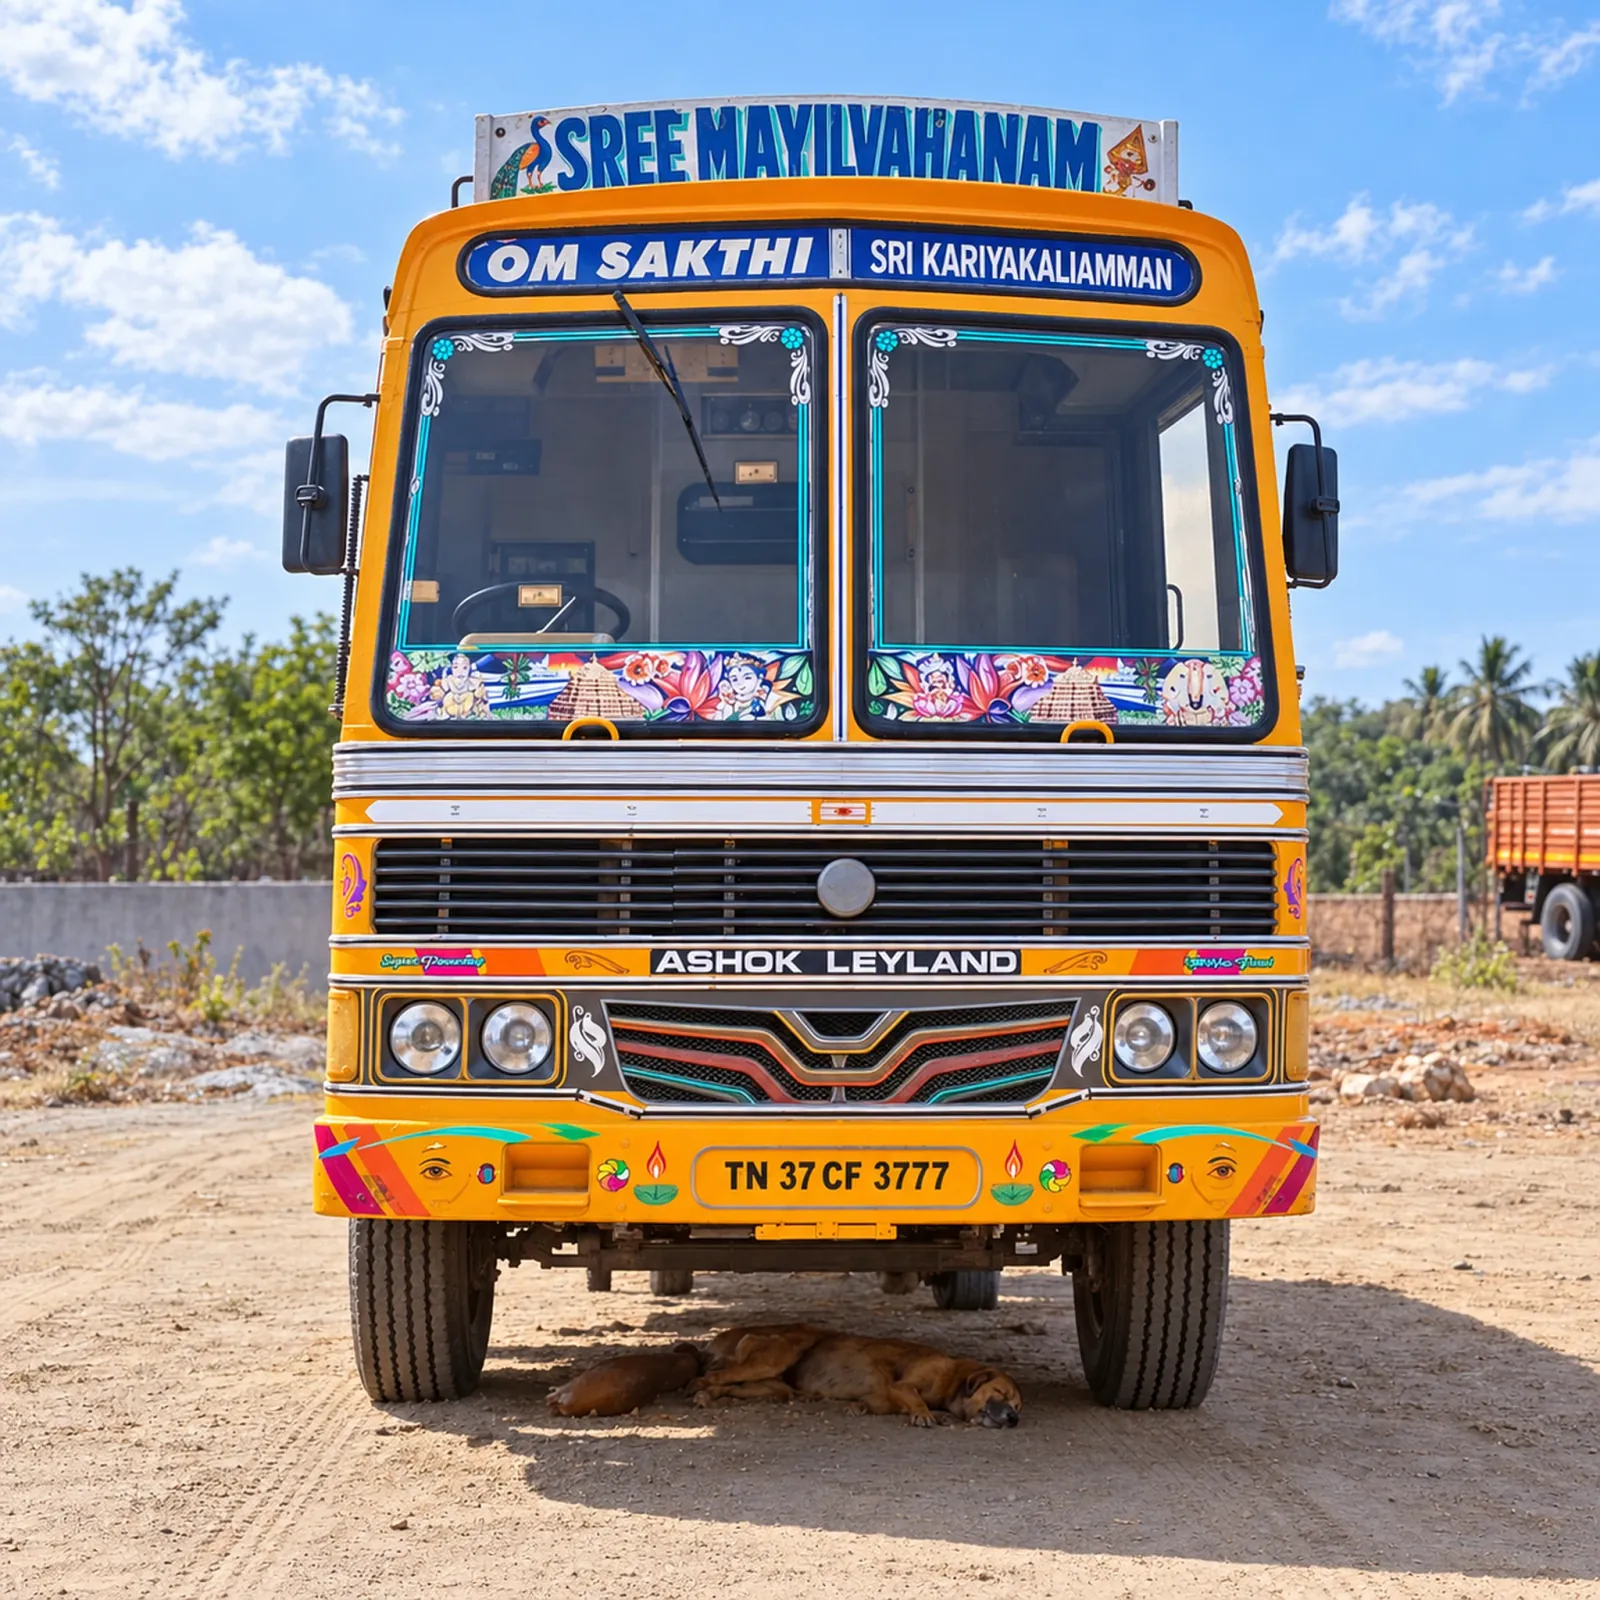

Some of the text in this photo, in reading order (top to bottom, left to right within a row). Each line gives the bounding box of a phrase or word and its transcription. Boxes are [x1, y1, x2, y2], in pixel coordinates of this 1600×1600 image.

[555, 103, 1101, 192] SREE MAYILVAHANAM
[487, 237, 814, 282] OM SAKTHI
[870, 239, 1173, 290] SRI KARIYAKALIAMMAN
[655, 951, 1017, 973] ASHOK LEYLAND
[725, 1161, 950, 1190] TN 37 CF 3777
